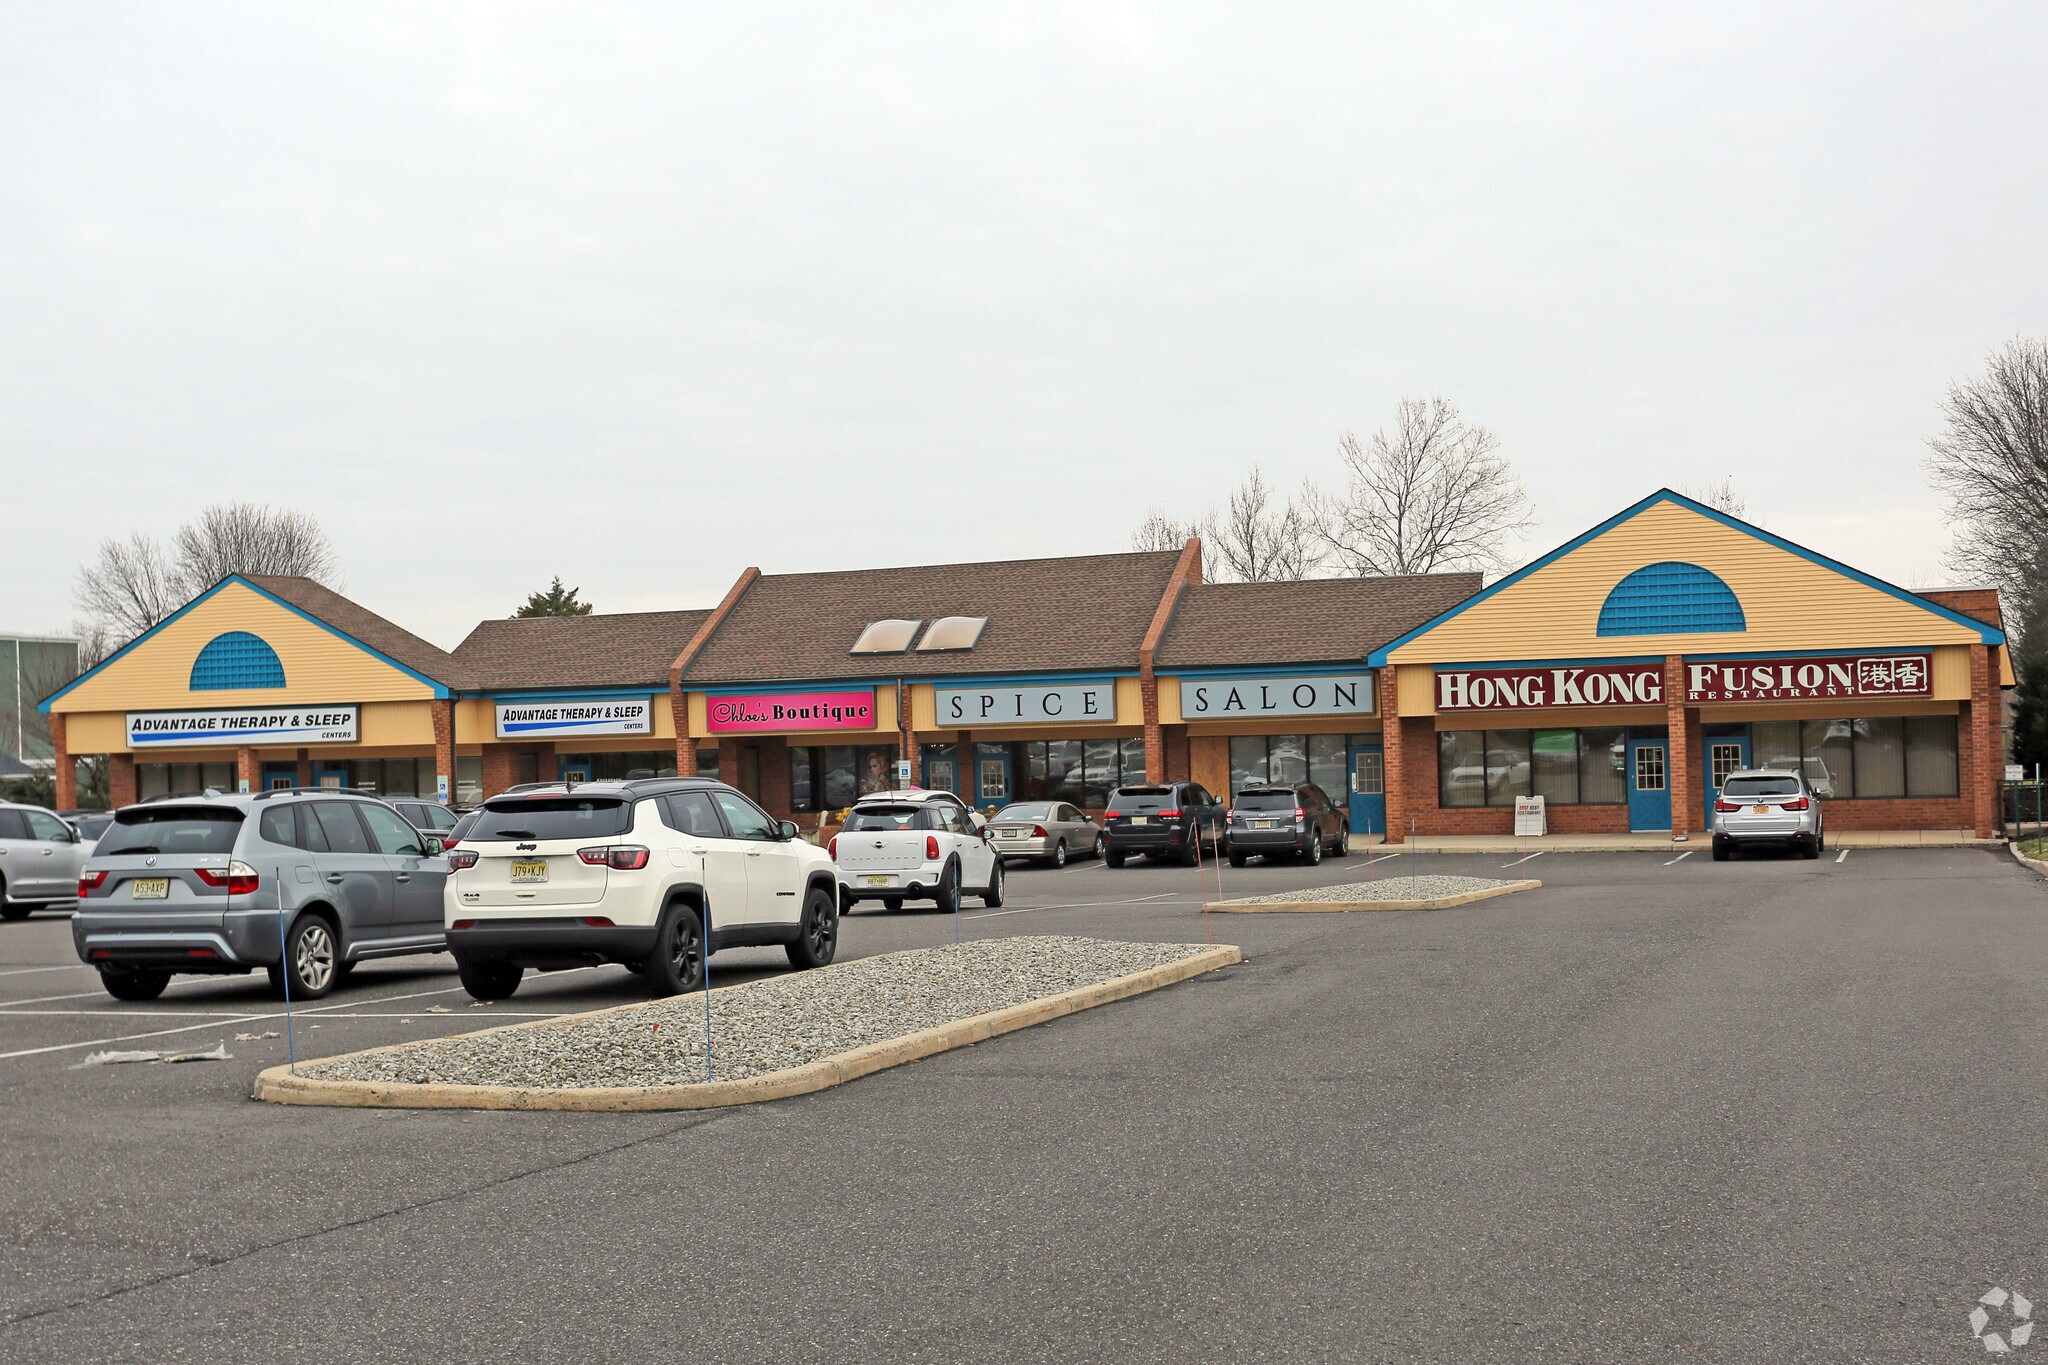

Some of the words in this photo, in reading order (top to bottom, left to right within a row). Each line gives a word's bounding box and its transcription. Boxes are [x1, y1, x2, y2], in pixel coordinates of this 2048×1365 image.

[1687, 662, 1854, 692] FUSION
[1195, 682, 1358, 712] SALON
[1437, 673, 1546, 708] HONG
[1550, 669, 1663, 705] KONG
[1689, 686, 1855, 700] RESTAURANT
[503, 708, 559, 722] ADVANTAGE
[560, 707, 603, 720] THERAPY
[604, 707, 612, 718] &
[613, 706, 643, 718] SLEEP
[712, 702, 769, 723] Chloe's
[772, 703, 869, 722] Boutique
[951, 691, 1099, 719] SPICE
[131, 715, 216, 731] ADVANTAGE
[220, 715, 288, 729] THERAPY
[290, 715, 301, 727] &
[305, 713, 351, 726] SLEEP
[623, 722, 644, 730] CENTERS
[321, 731, 352, 739] CENTERS
[515, 842, 537, 851] Jeep
